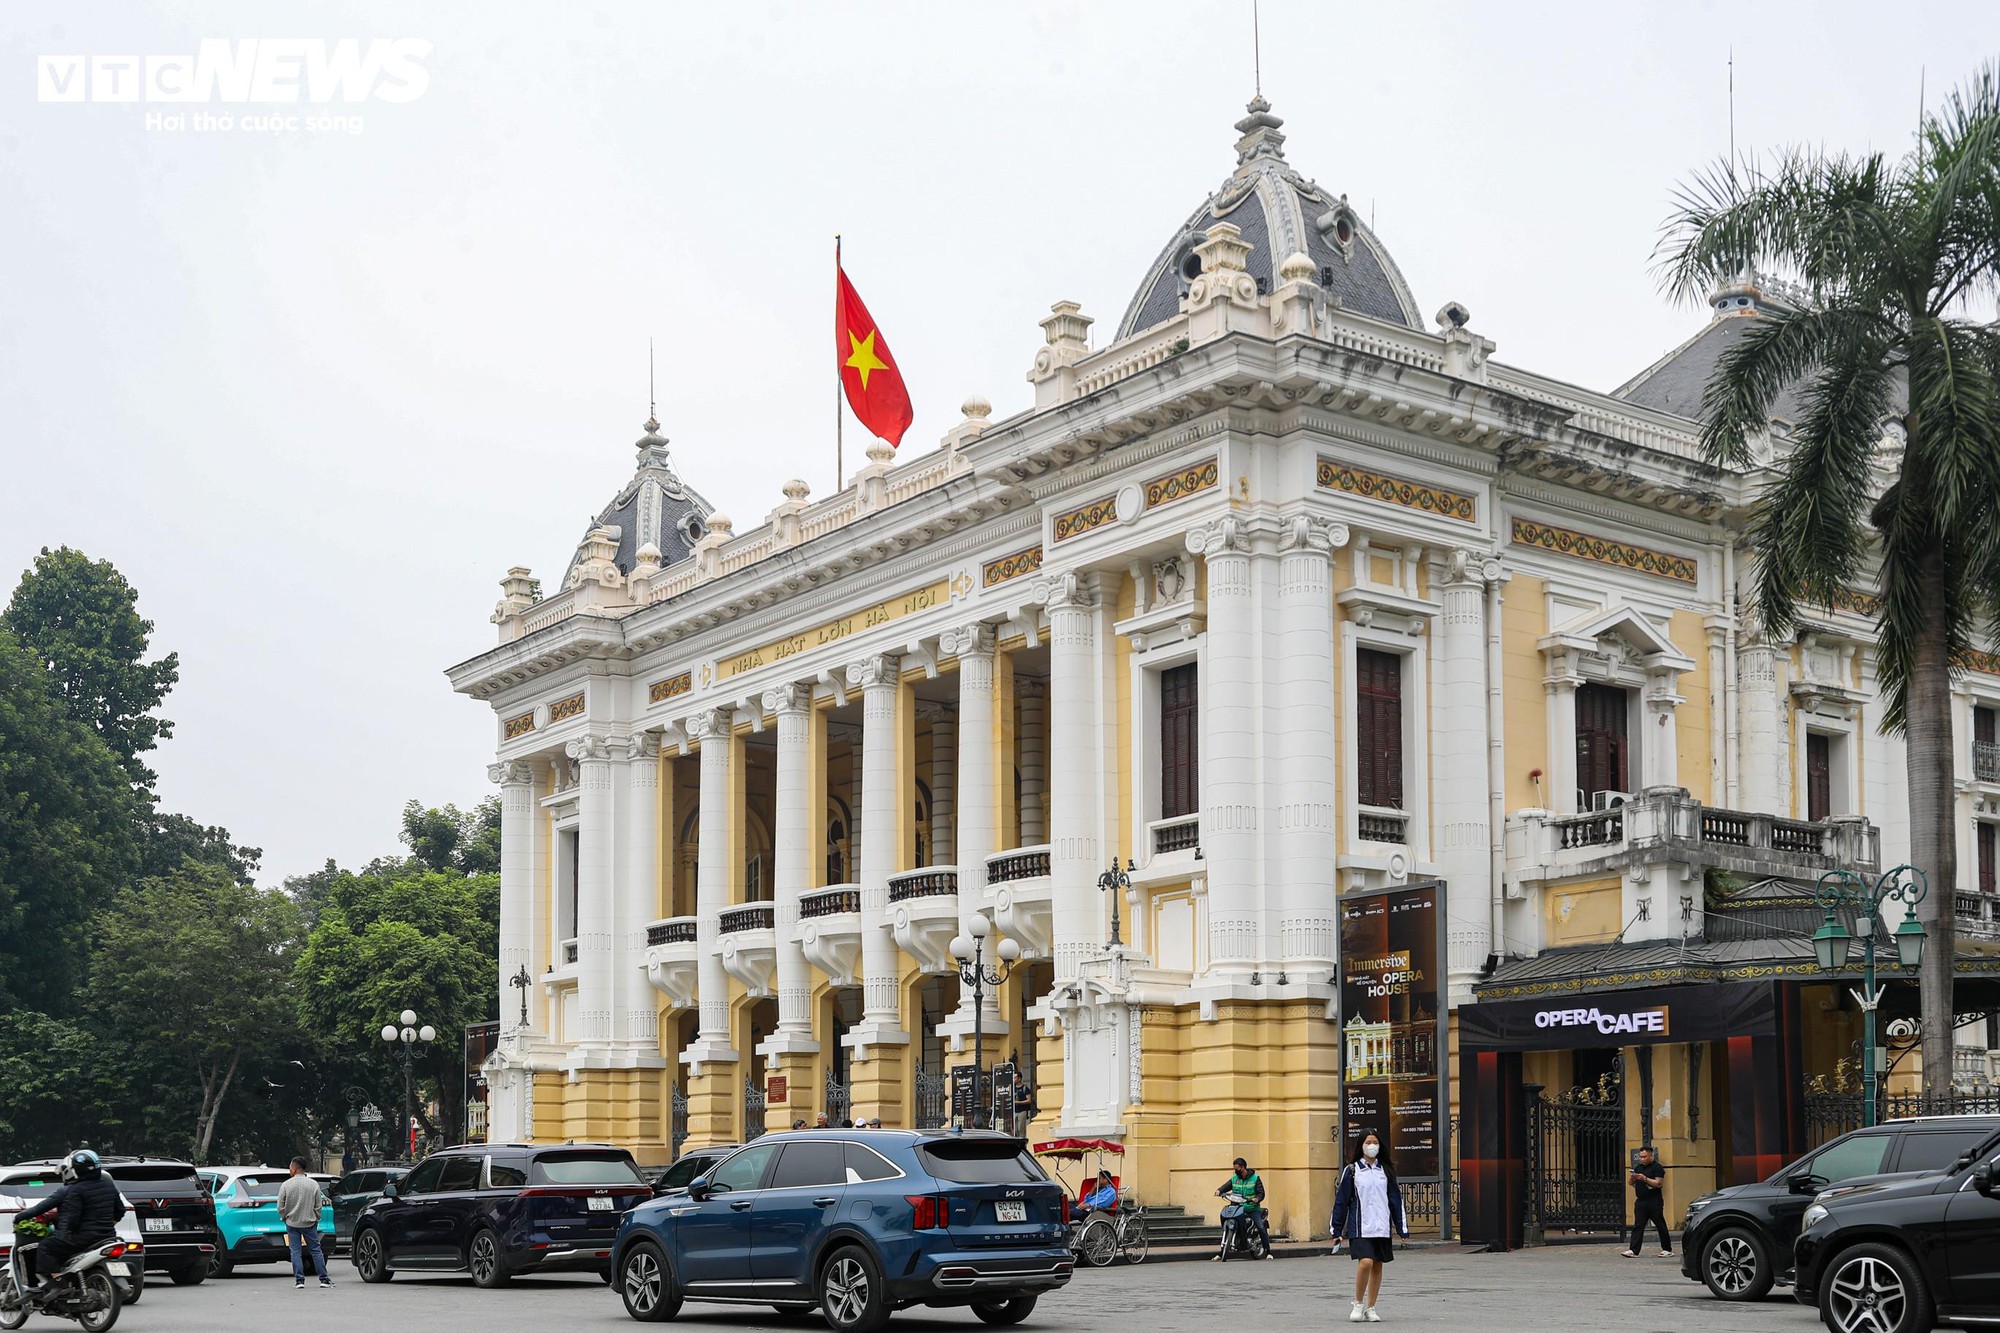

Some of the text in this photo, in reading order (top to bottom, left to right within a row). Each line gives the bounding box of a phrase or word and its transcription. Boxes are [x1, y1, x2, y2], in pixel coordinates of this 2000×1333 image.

[732, 588, 936, 676] NHÀ HÁT LỚN HÀ NỘI
[1348, 954, 1407, 972] Immersive
[1382, 969, 1424, 985] OPERA
[1367, 982, 1410, 997] HOUSE
[1534, 1007, 1664, 1034] OPERA CAFE
[1005, 1189, 1025, 1197] KIA
[984, 1233, 1045, 1241] SORENTO
